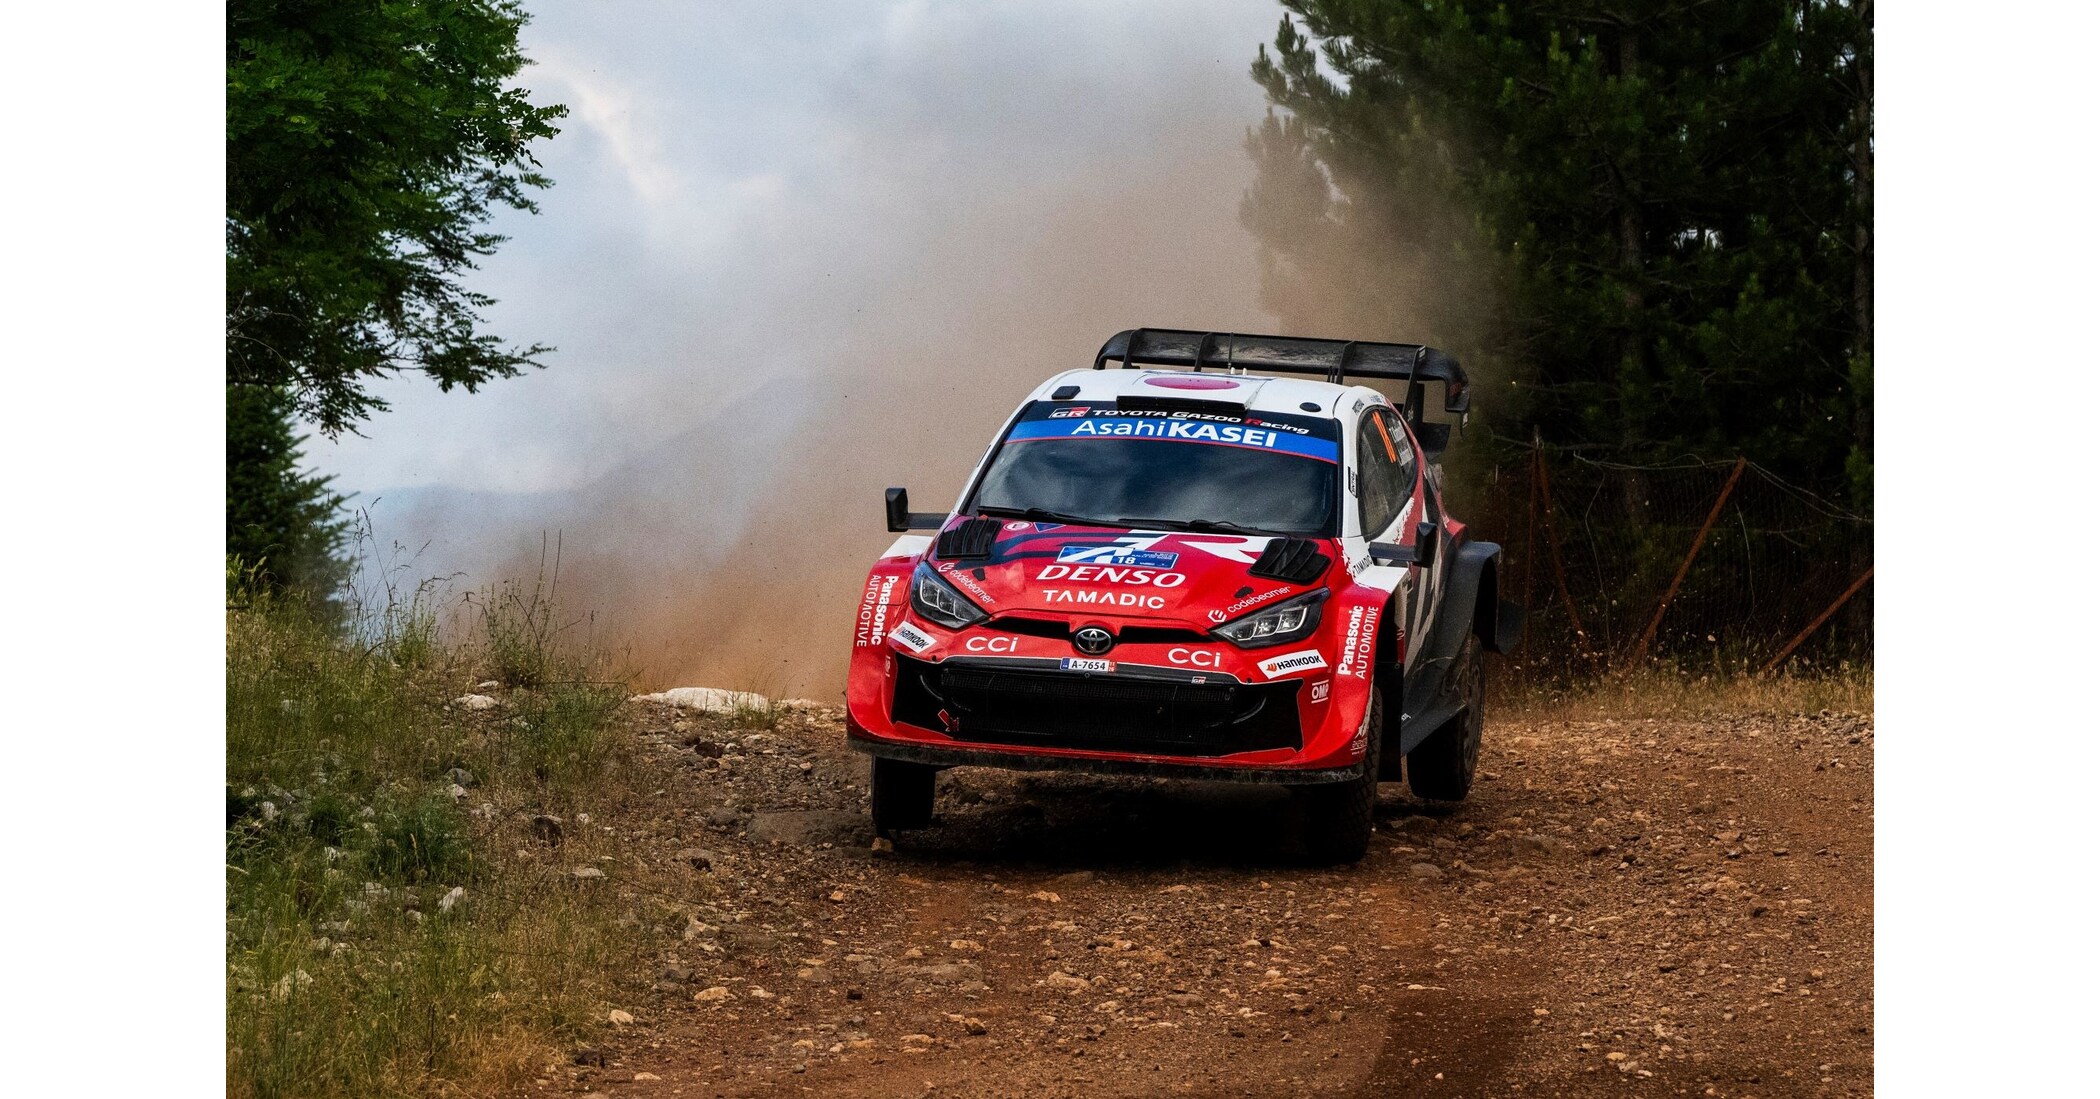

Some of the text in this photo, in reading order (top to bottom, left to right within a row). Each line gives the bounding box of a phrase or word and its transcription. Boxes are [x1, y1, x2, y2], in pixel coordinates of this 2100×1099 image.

[1050, 408, 1310, 435] GR TOYOTA GAZOO Racing
[1071, 420, 1277, 448] AsahiKASEI
[1117, 556, 1136, 564] 18
[950, 569, 995, 605] codebeamer
[1035, 565, 1186, 588] DENSO
[856, 575, 882, 647] AUTOMOTIVE
[871, 575, 899, 646] Panasonic
[1042, 589, 1165, 609] TAMADIC
[1227, 586, 1291, 613] codebeamer
[1337, 605, 1364, 676] Panasonic
[1355, 605, 1379, 680] AUTOMOTIVE
[1071, 660, 1106, 670] A-7654
[1311, 683, 1329, 700] OMP
